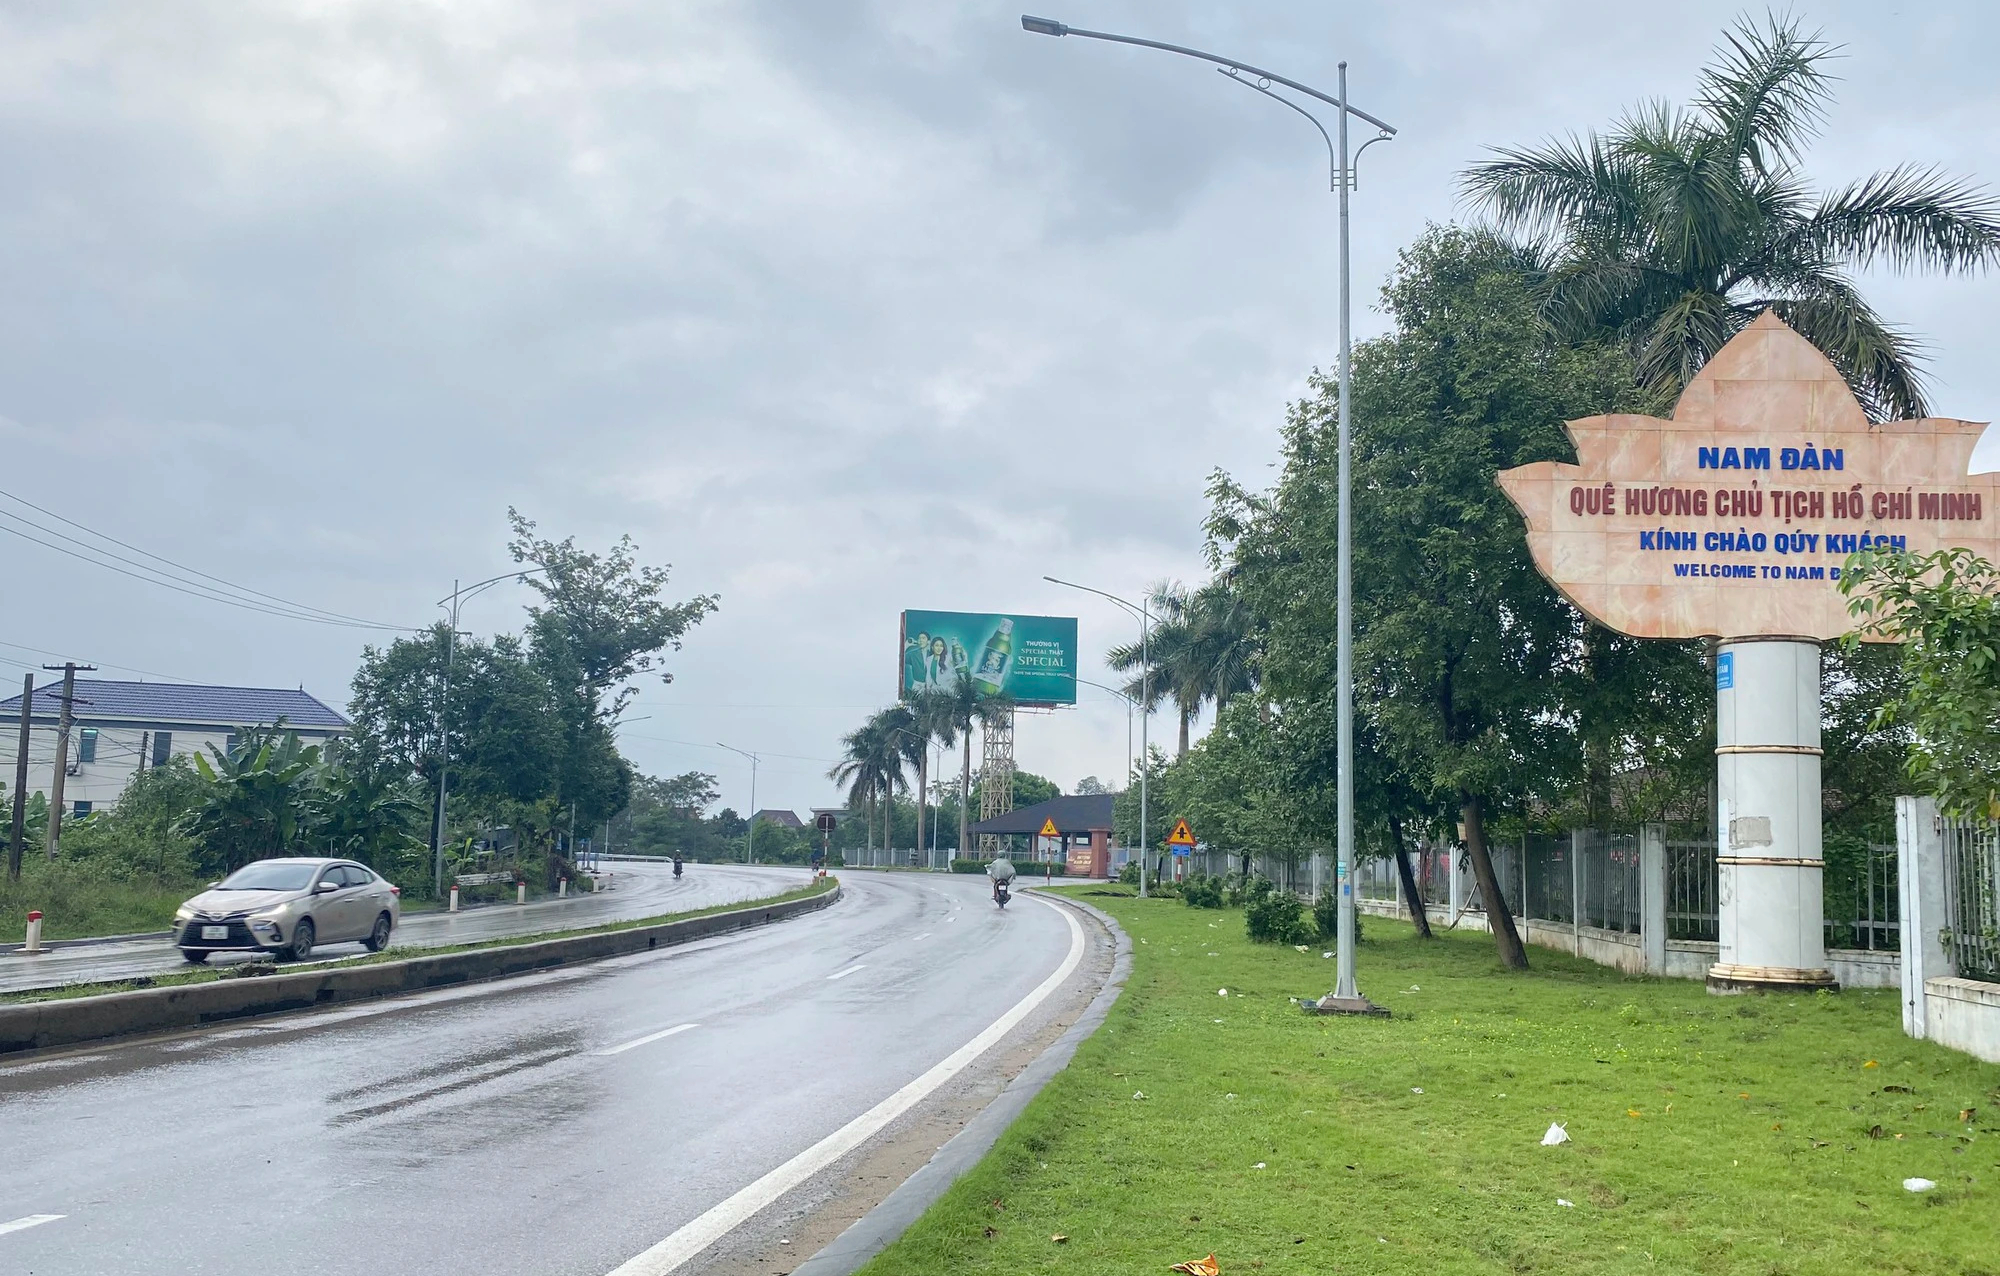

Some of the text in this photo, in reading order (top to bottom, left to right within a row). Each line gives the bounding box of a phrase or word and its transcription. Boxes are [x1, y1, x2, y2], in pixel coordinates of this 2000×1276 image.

[1698, 441, 1844, 471] NAM ĐÀN
[1570, 481, 1616, 516] QUÊ
[1625, 486, 1707, 516] HƯƠNG
[1715, 479, 1763, 517] CHỦ
[1770, 489, 1824, 524] TỊCH
[1872, 486, 1912, 520] CHÍ
[1918, 492, 1982, 520] MINH
[1640, 526, 1906, 554] KÍNH CHÀO QÚY KHÁCH
[1673, 563, 1756, 578] WELCOME
[1761, 565, 1781, 579] TO
[1785, 566, 1824, 580] NAM
[1018, 656, 1067, 667] SPECIAL
